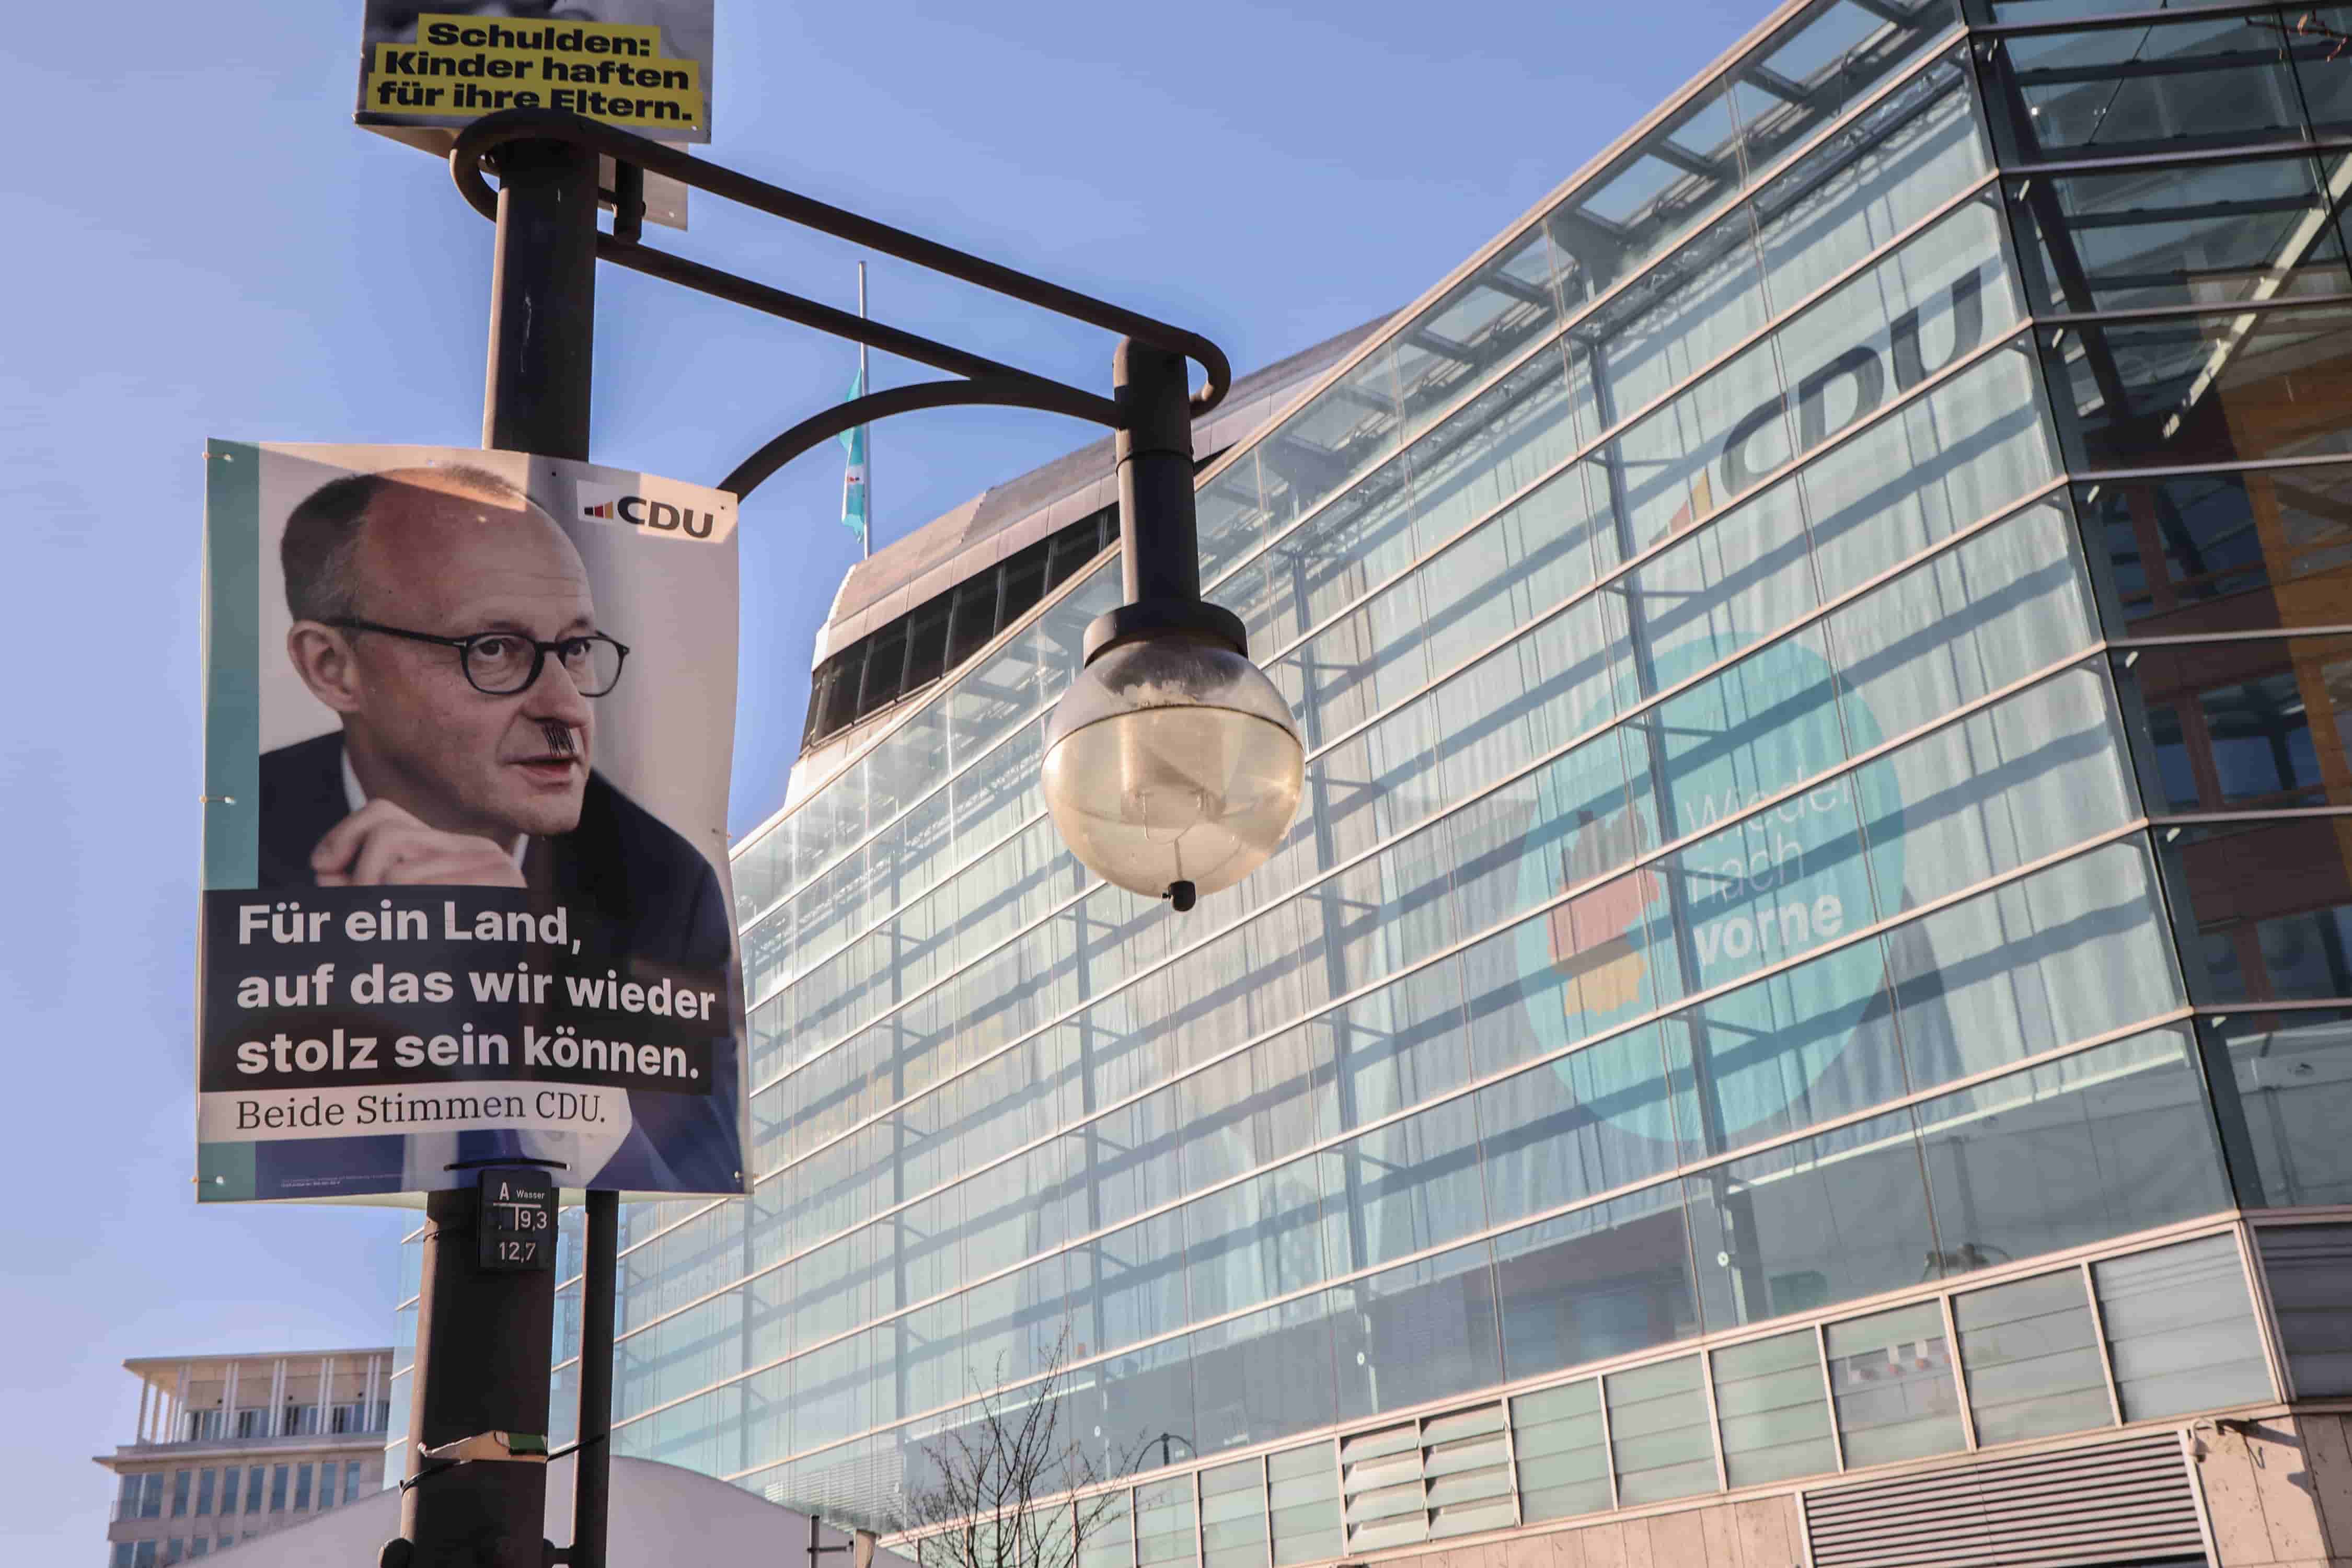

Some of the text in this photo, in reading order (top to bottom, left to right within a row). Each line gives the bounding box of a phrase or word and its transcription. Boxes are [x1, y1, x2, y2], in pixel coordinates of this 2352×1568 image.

[427, 22, 650, 57] Schulden:
[385, 51, 689, 90] Kinder haften
[377, 80, 693, 121] für ihre Eltern.
[1720, 265, 1984, 498] CDU
[617, 495, 713, 539] CDU
[1692, 832, 1804, 908] nach
[239, 899, 581, 955] Für ein Land,
[1692, 894, 1844, 966] vorne
[237, 961, 716, 1021] auf das wir wieder
[236, 1022, 699, 1079] stolz sein können.
[236, 1091, 606, 1130] Beide Stimmen CDU.
[499, 1182, 545, 1201] A Wasser
[499, 1241, 536, 1263] 12,7
